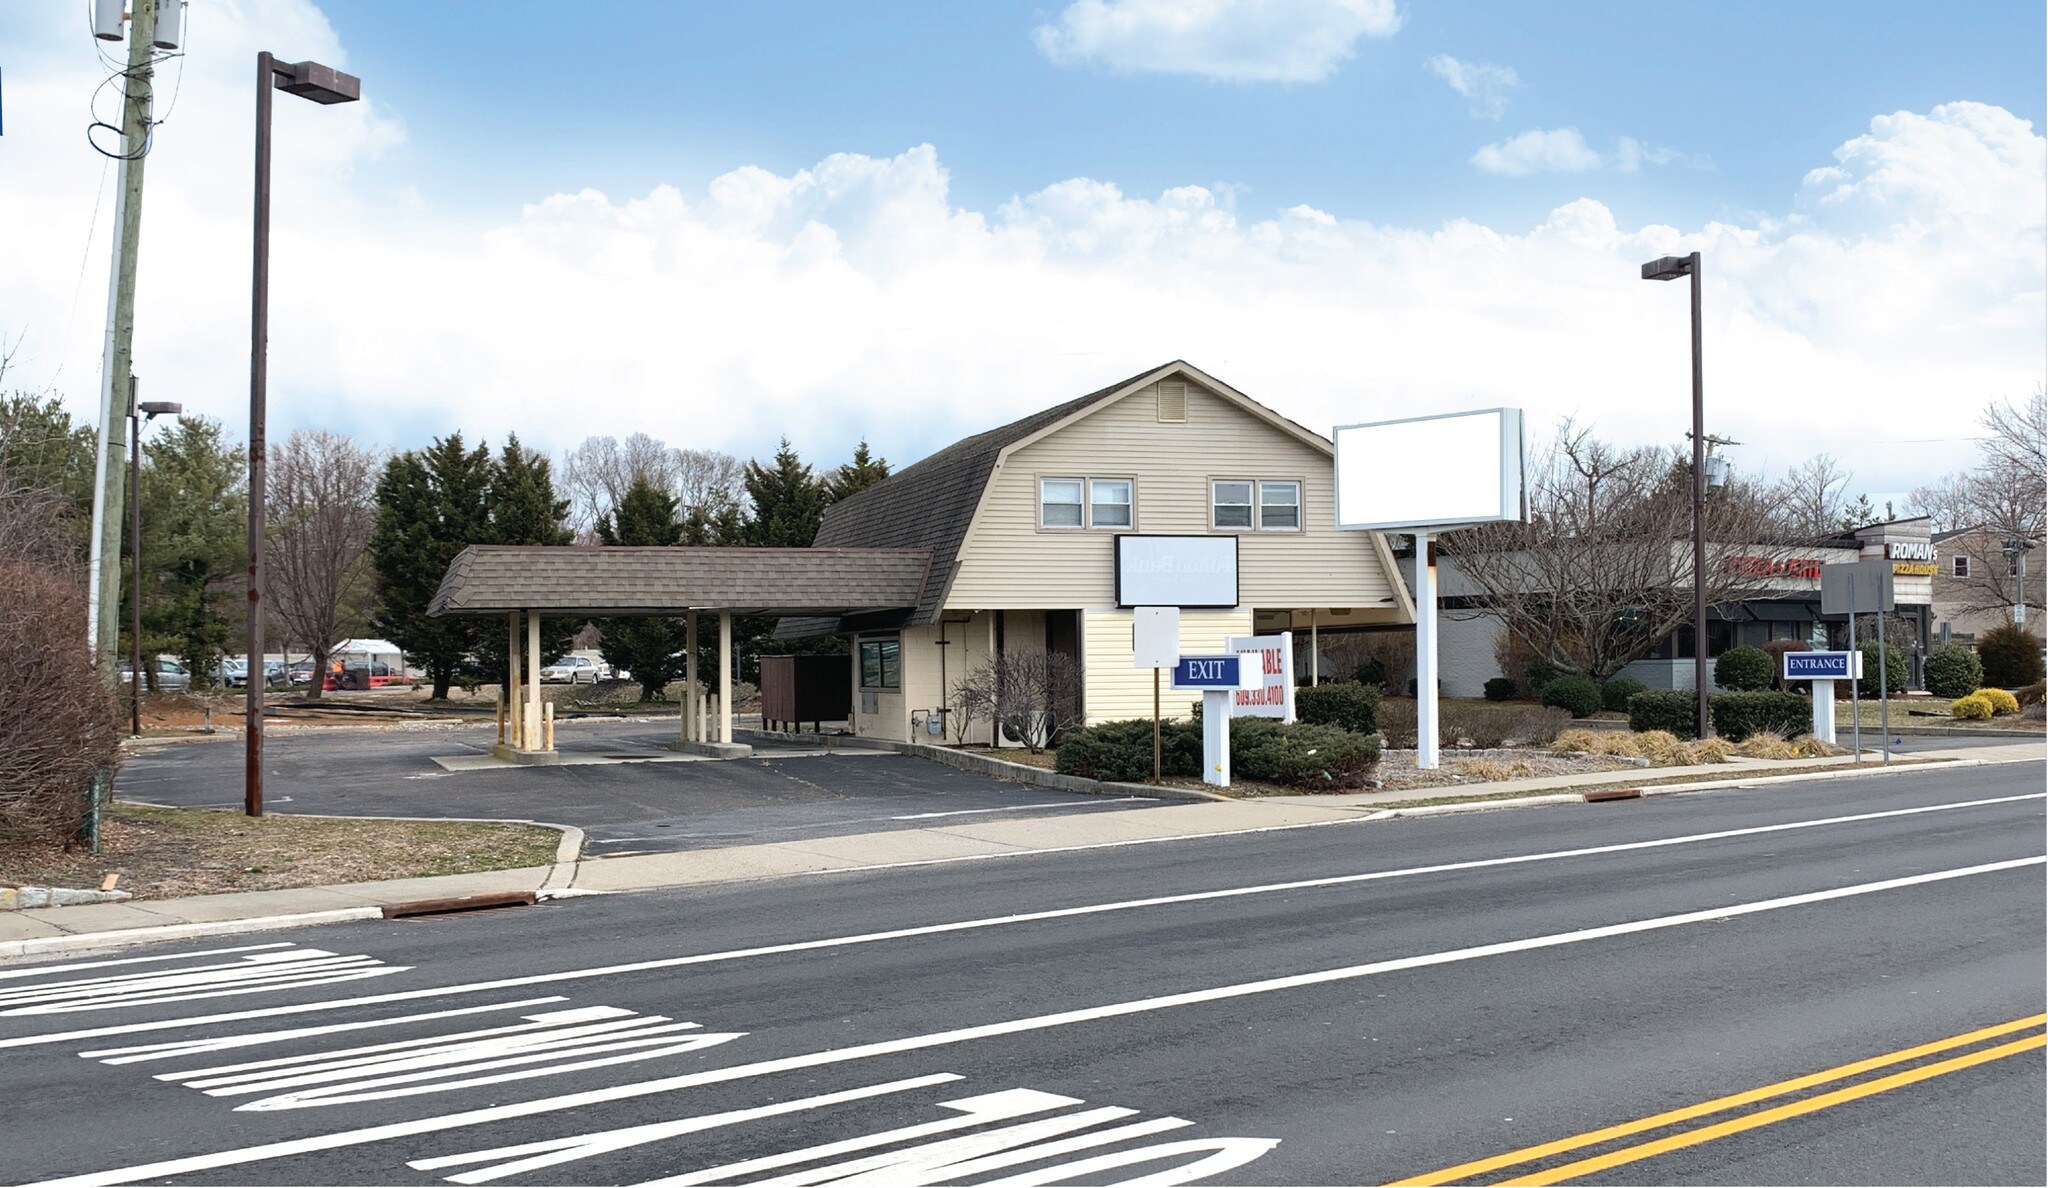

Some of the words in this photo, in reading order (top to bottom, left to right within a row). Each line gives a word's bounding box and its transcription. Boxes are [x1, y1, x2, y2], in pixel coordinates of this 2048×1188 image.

[1893, 563, 1914, 575] PIZZA
[1188, 660, 1225, 680] EXIT
[1790, 658, 1845, 669] ENTRANCE
[1235, 685, 1284, 706] 609.330.4100
[78, 995, 750, 1112] ONLY
